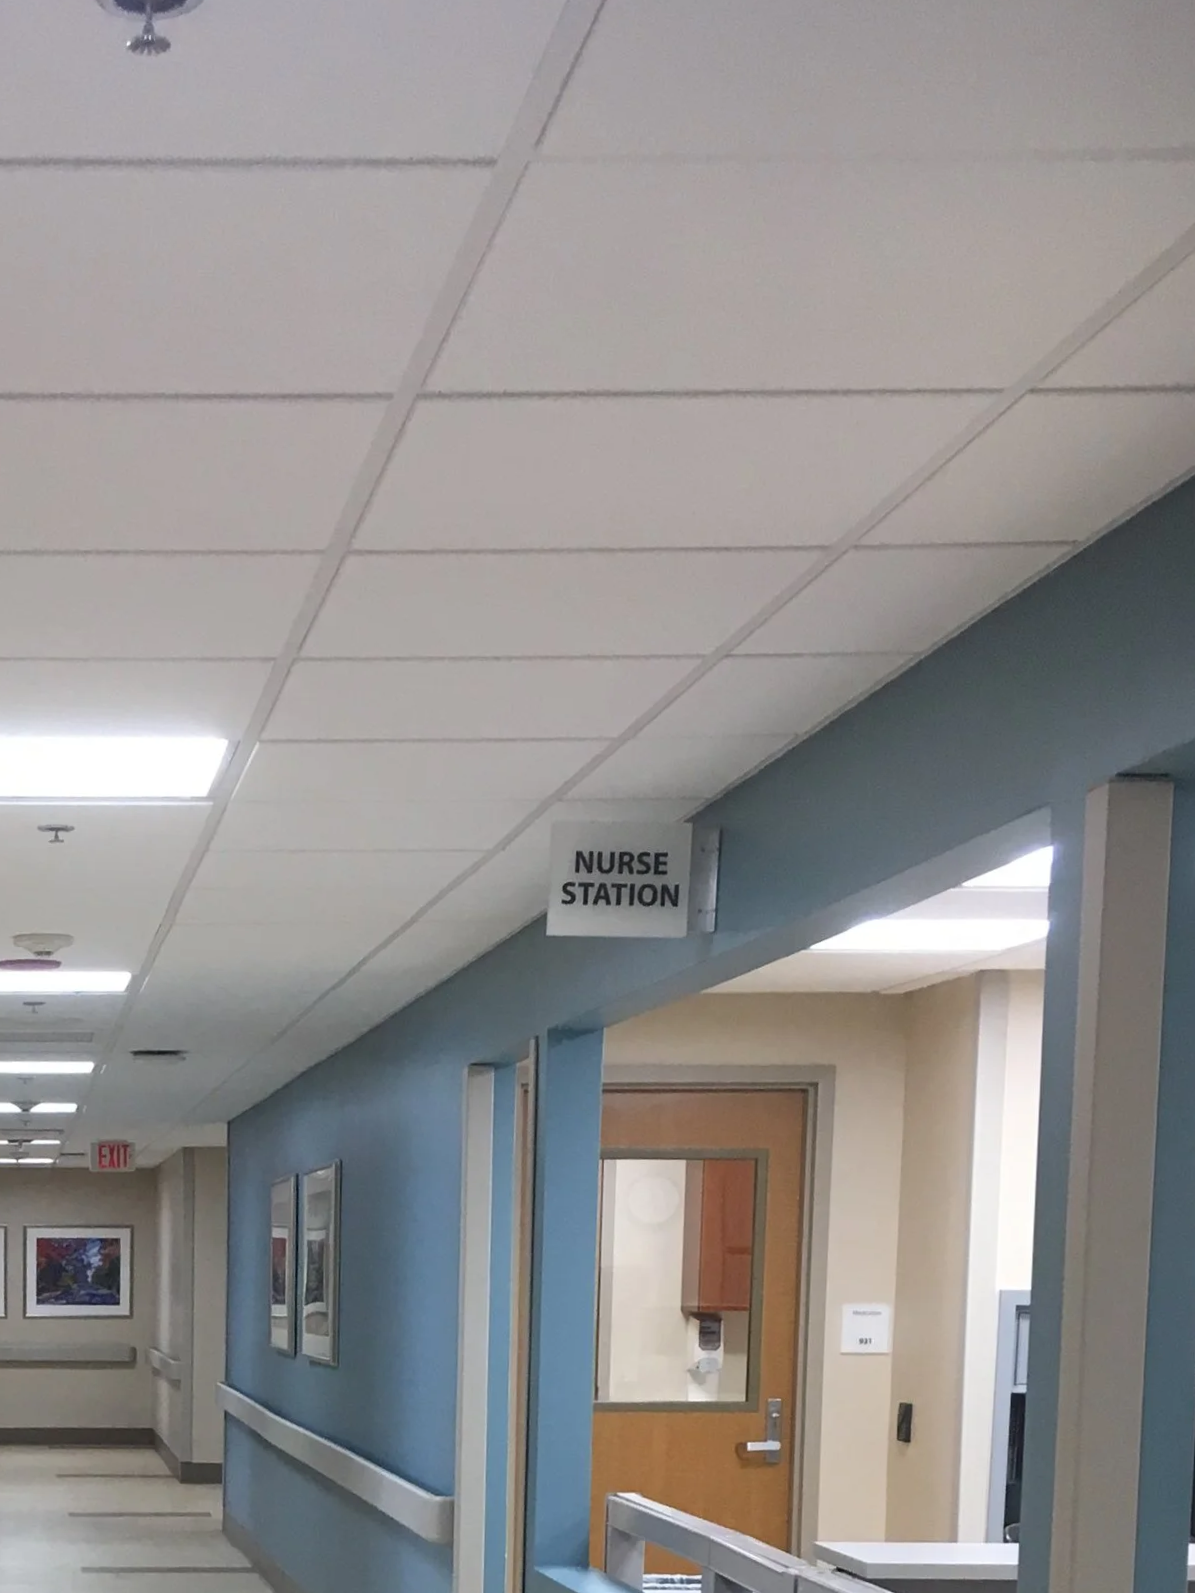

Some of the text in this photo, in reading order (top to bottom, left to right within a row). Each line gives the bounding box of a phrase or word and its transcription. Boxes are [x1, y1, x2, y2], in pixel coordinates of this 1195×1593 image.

[574, 850, 669, 876] NURSE
[560, 881, 680, 908] STATION
[98, 1144, 130, 1169] EXIT
